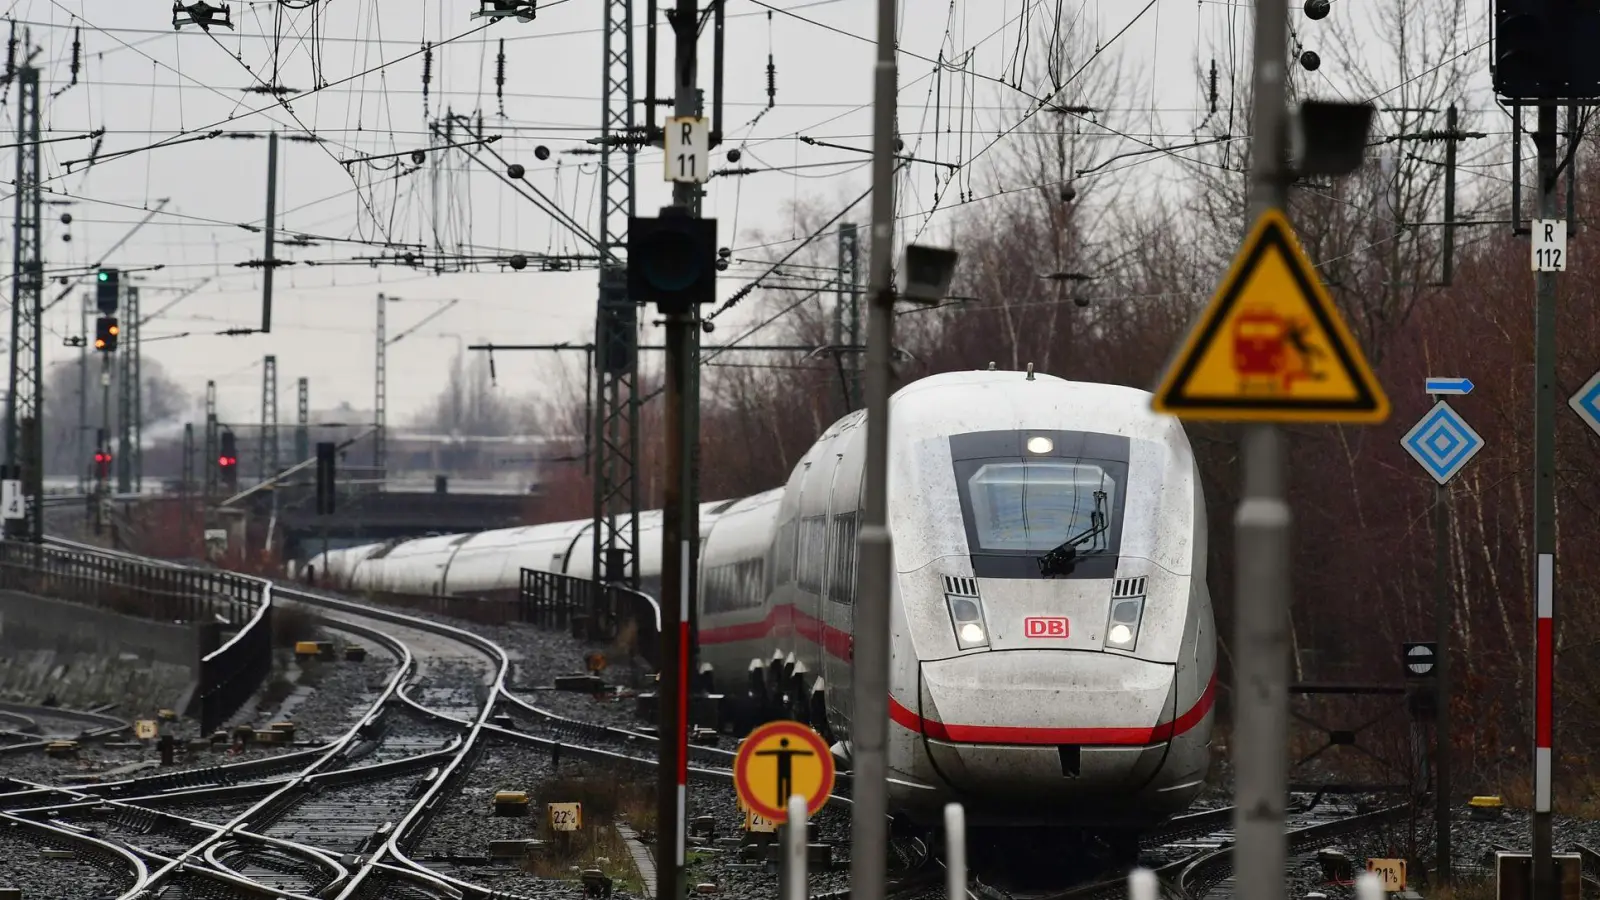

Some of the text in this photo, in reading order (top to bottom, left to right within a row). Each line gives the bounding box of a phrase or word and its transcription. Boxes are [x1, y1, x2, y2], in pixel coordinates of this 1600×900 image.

[682, 122, 692, 145] R
[677, 154, 695, 177] 11
[1545, 223, 1553, 242] R
[1536, 248, 1561, 267] 112
[1030, 620, 1064, 635] DB
